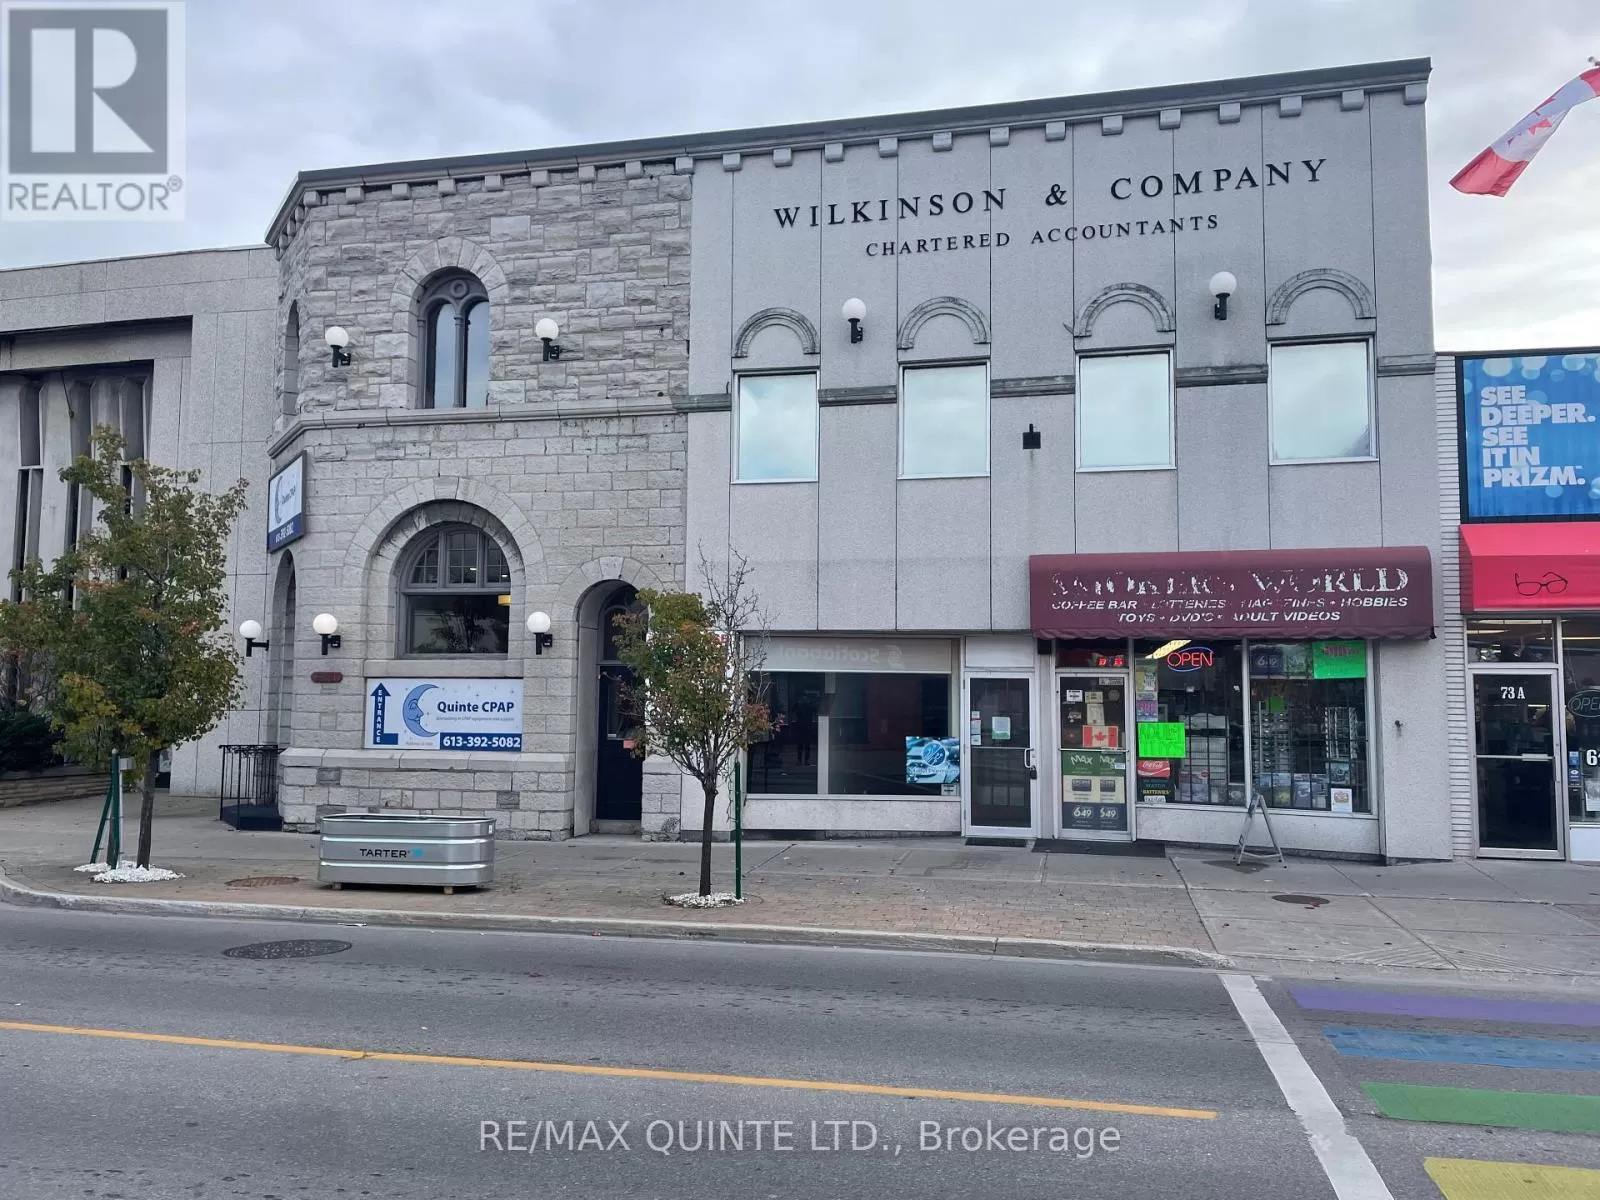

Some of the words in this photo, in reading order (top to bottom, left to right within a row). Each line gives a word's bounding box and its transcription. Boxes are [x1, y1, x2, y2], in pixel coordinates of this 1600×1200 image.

[774, 188, 1006, 229] WILKINSON
[1045, 183, 1068, 206] &
[1110, 158, 1327, 200] COMPANY
[866, 232, 1010, 257] CHARTERED
[1030, 214, 1218, 244] ACCOUNTANTS
[1480, 385, 1526, 406] SEE
[1480, 403, 1597, 426] DEEPER.
[1482, 426, 1528, 446] SEE
[1482, 448, 1507, 467] IT
[1510, 446, 1540, 466] IN
[1108, 600, 1138, 610] BAR
[1151, 599, 1226, 609] LTTERIES
[1240, 598, 1325, 608] MAGZINES
[1340, 597, 1408, 608] HOBBIES
[1119, 613, 1156, 623] TOYS
[1284, 611, 1341, 621] VIDEOS
[1167, 651, 1213, 667] OPEN
[1500, 686, 1515, 699] 73
[1517, 686, 1526, 699] A
[437, 701, 479, 713] Quinte
[481, 701, 514, 713] CPAP
[1571, 696, 1600, 712] OPE
[443, 736, 521, 748] 613-392-5082
